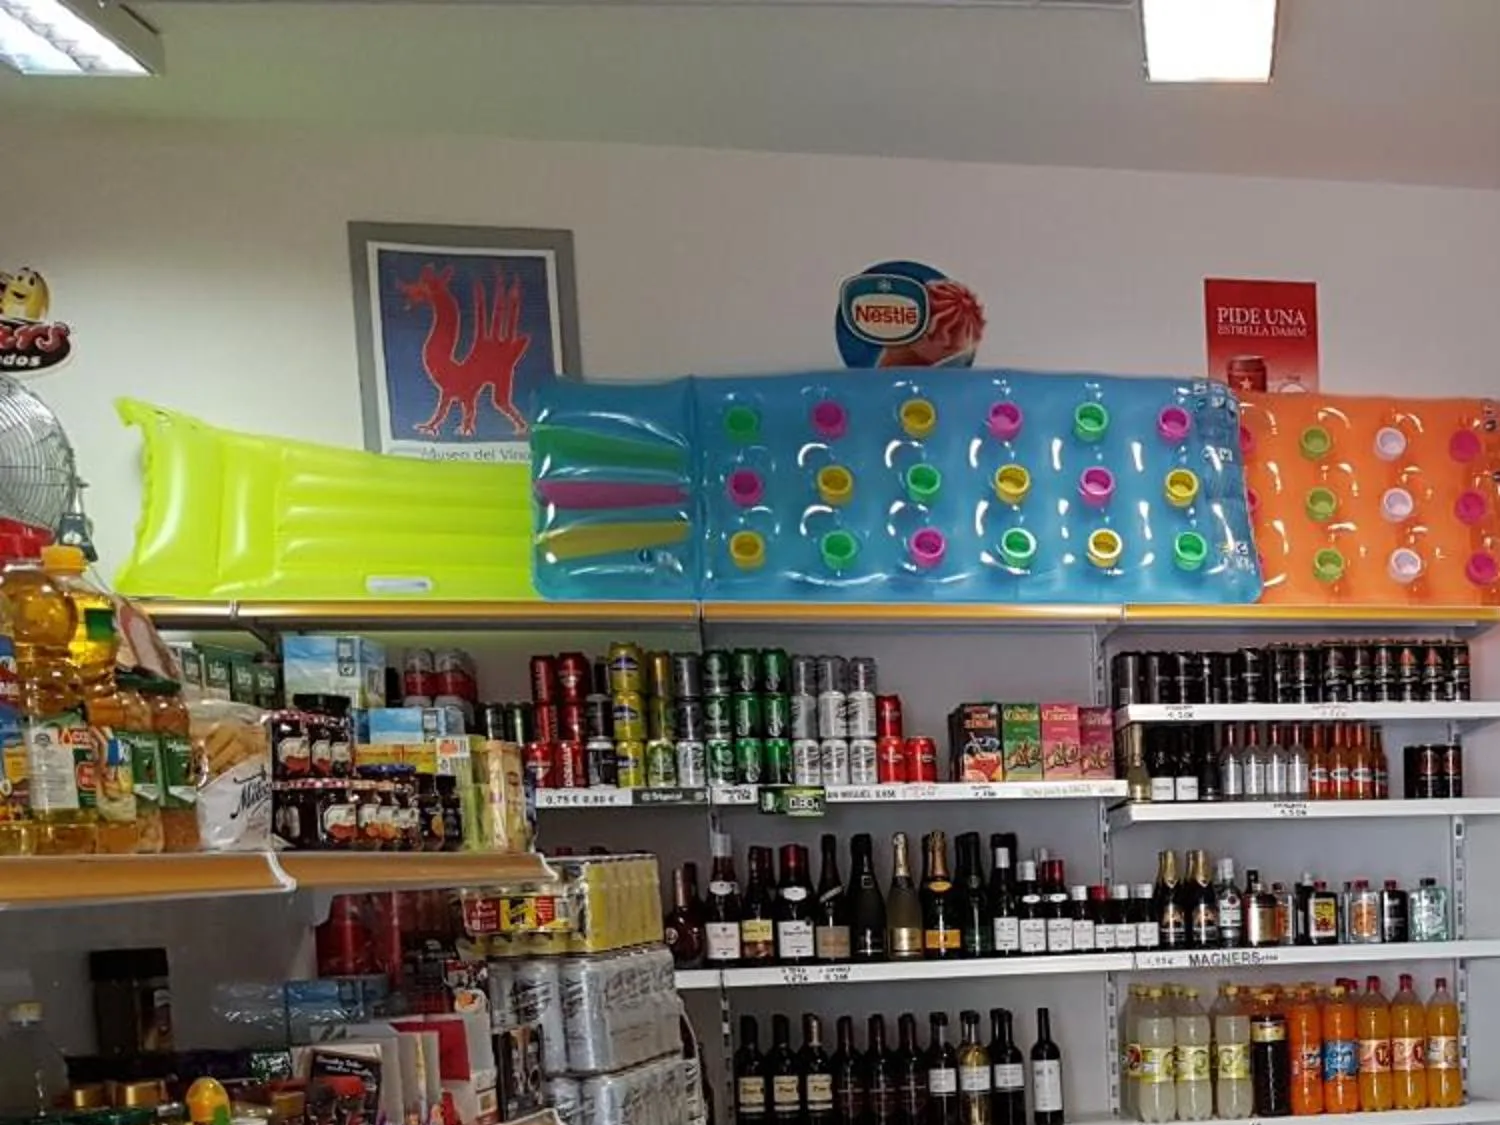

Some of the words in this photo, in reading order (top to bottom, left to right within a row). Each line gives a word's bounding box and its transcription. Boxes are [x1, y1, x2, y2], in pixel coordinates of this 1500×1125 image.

[1217, 306, 1260, 325] PIDE
[1265, 307, 1307, 326] UNA
[1217, 323, 1269, 337] ESTRELLA
[1271, 325, 1307, 338] DAMM
[1188, 951, 1261, 967] MAGNERS
